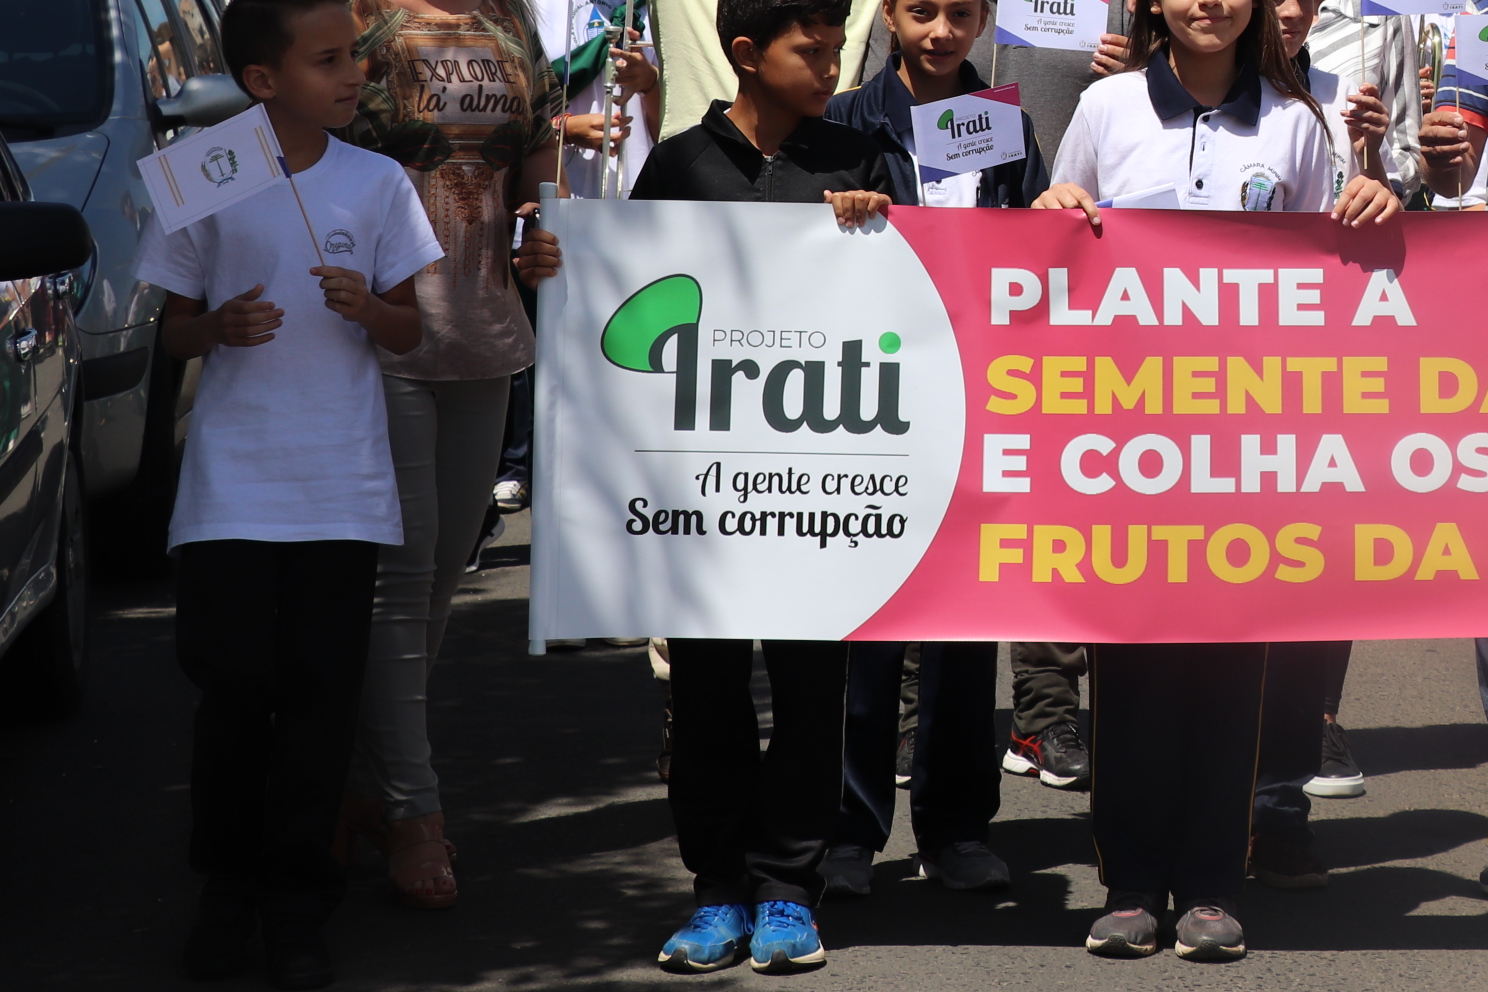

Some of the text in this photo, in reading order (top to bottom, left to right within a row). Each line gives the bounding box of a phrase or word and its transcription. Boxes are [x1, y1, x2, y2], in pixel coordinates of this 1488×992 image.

[585, 0, 612, 9] ANTONIO
[1040, 27, 1074, 35] corrupção
[408, 59, 516, 84] EXPLORE
[460, 84, 524, 114] alma
[946, 111, 992, 139] Irati
[946, 144, 994, 161] Sem corrupção
[990, 267, 1418, 326] PLANTE A
[712, 329, 827, 348] PROJETO
[648, 322, 910, 436] Irati
[985, 354, 1390, 415] SEMENTE
[695, 461, 909, 503] A gente cresce
[982, 434, 1032, 493] E
[1060, 433, 1366, 495] COLHA
[626, 497, 908, 549] Sem corrupção
[978, 522, 1325, 584] FRUTOS
[1354, 522, 1480, 582] DA
